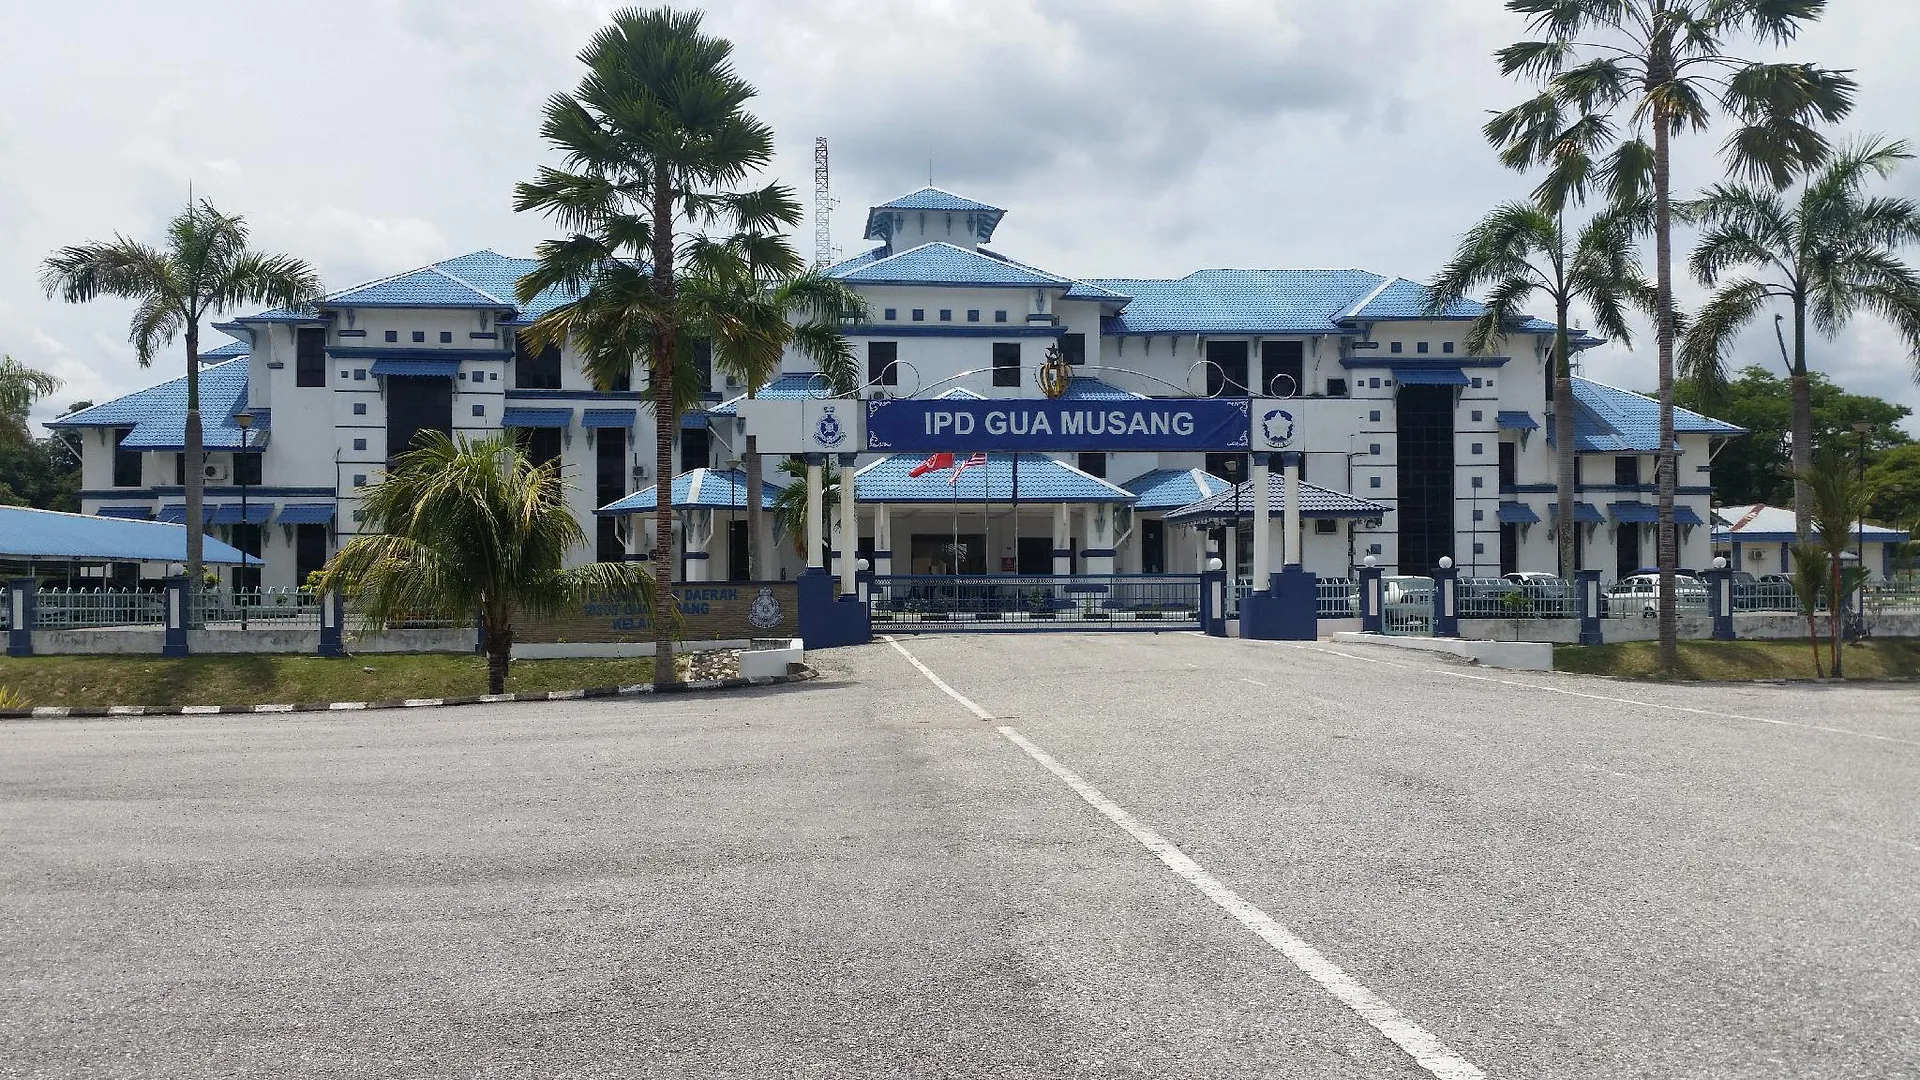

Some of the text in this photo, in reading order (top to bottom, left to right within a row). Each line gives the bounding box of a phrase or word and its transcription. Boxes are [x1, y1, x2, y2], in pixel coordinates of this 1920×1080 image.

[925, 411, 1194, 436] IPD GUA MUSANG
[684, 588, 737, 601] DAERAH
